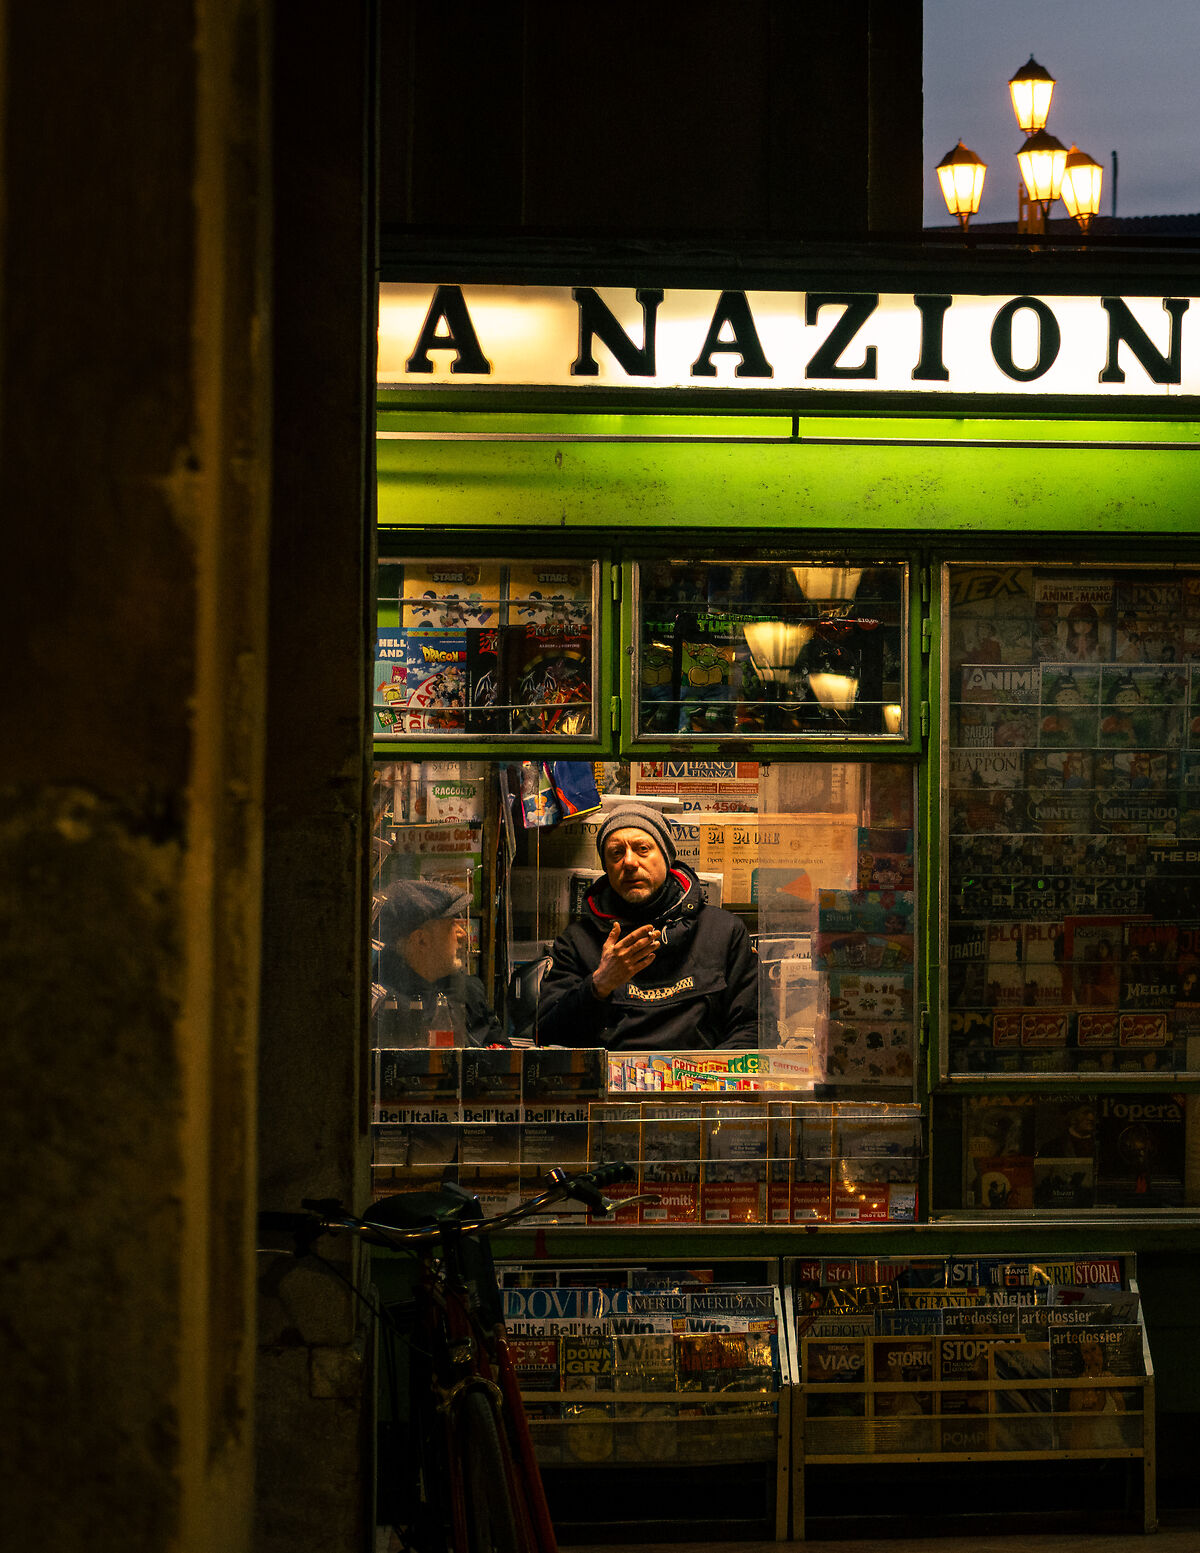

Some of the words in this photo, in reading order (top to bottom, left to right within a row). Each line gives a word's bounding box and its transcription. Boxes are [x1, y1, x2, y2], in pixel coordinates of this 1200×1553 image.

[405, 284, 492, 375] A
[432, 573, 464, 583] STARS
[950, 567, 1025, 604] TEX
[379, 649, 404, 657] AND
[435, 786, 475, 796] RACCOLTA
[683, 802, 702, 811] DA
[1102, 807, 1178, 819] NINTENDO
[733, 832, 750, 844] 24
[1150, 851, 1185, 862] THE
[1101, 1097, 1182, 1122] l'opera
[379, 1110, 449, 1123] Bell'Italia
[1076, 1264, 1119, 1285] STORIA
[693, 1295, 772, 1310] MERIDIANI
[505, 1323, 545, 1335] ell'Ita
